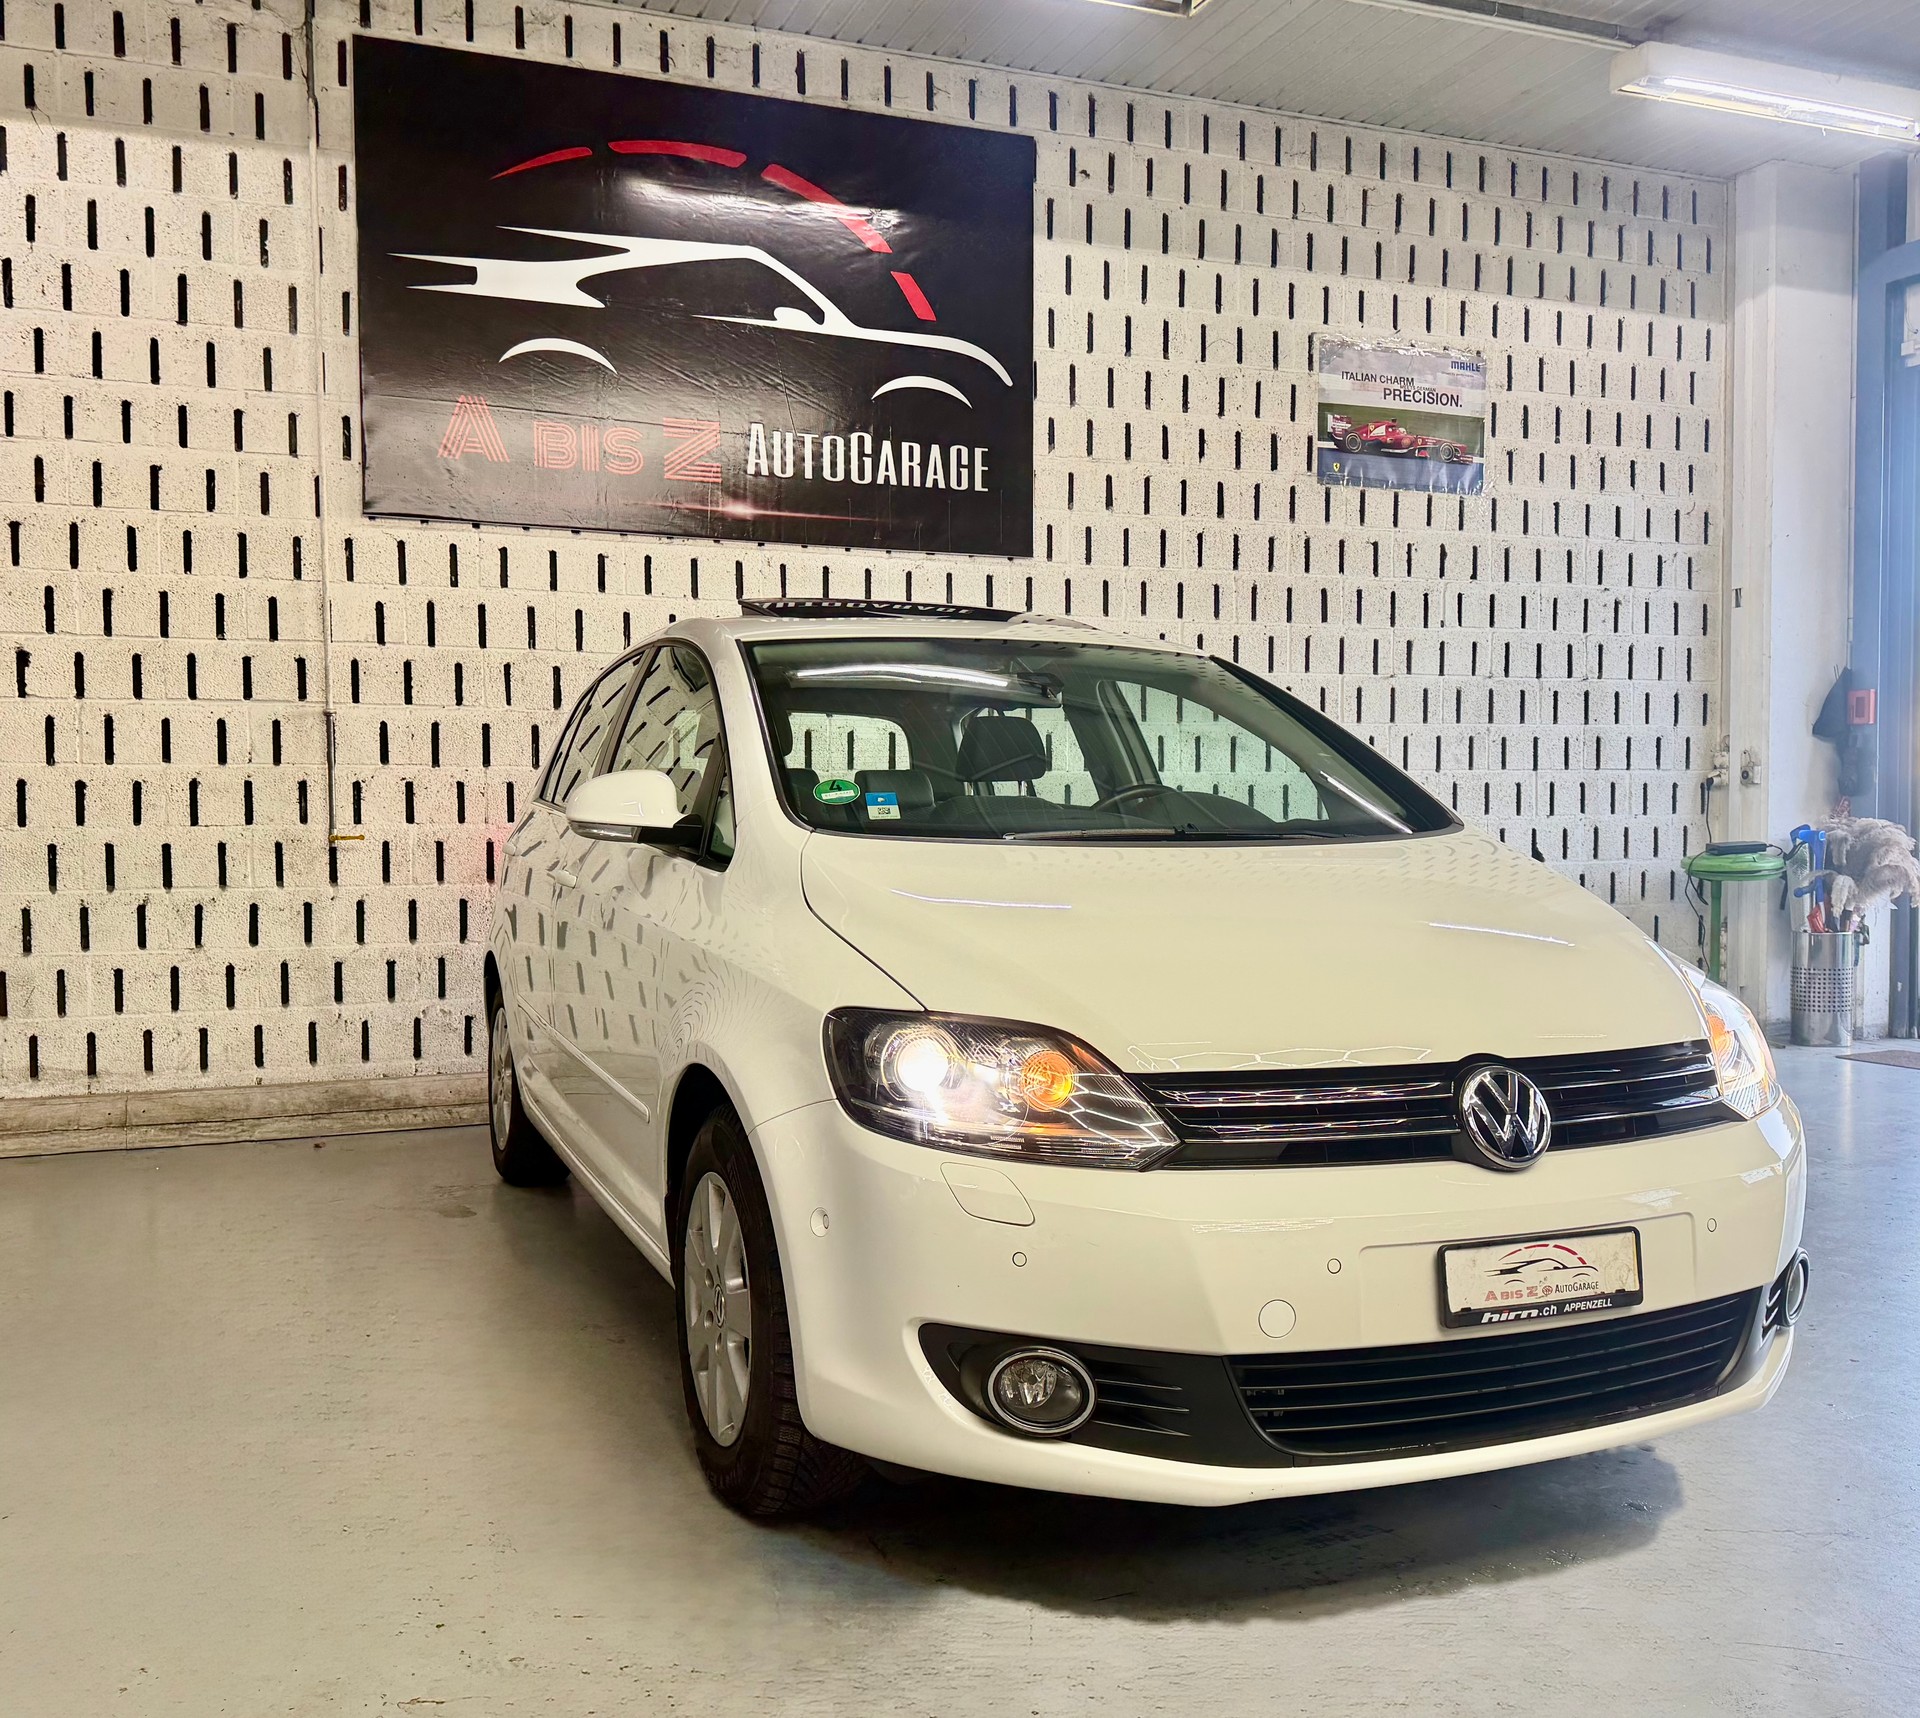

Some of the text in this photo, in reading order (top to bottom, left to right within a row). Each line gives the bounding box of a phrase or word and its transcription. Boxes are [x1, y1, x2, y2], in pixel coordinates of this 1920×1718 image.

[1451, 360, 1481, 372] MAHLE
[1341, 371, 1415, 386] ITALIAN CHARM
[1383, 388, 1463, 408] PRECISION.
[437, 394, 510, 463] A
[532, 419, 645, 476] BIS
[662, 417, 722, 484] Z
[829, 780, 843, 791] 4
[1484, 1291, 1499, 1301] A
[1500, 1290, 1524, 1300] BIS
[1526, 1286, 1539, 1297] Z
[1481, 1298, 1613, 1324] hirn.ch APPENZELL
